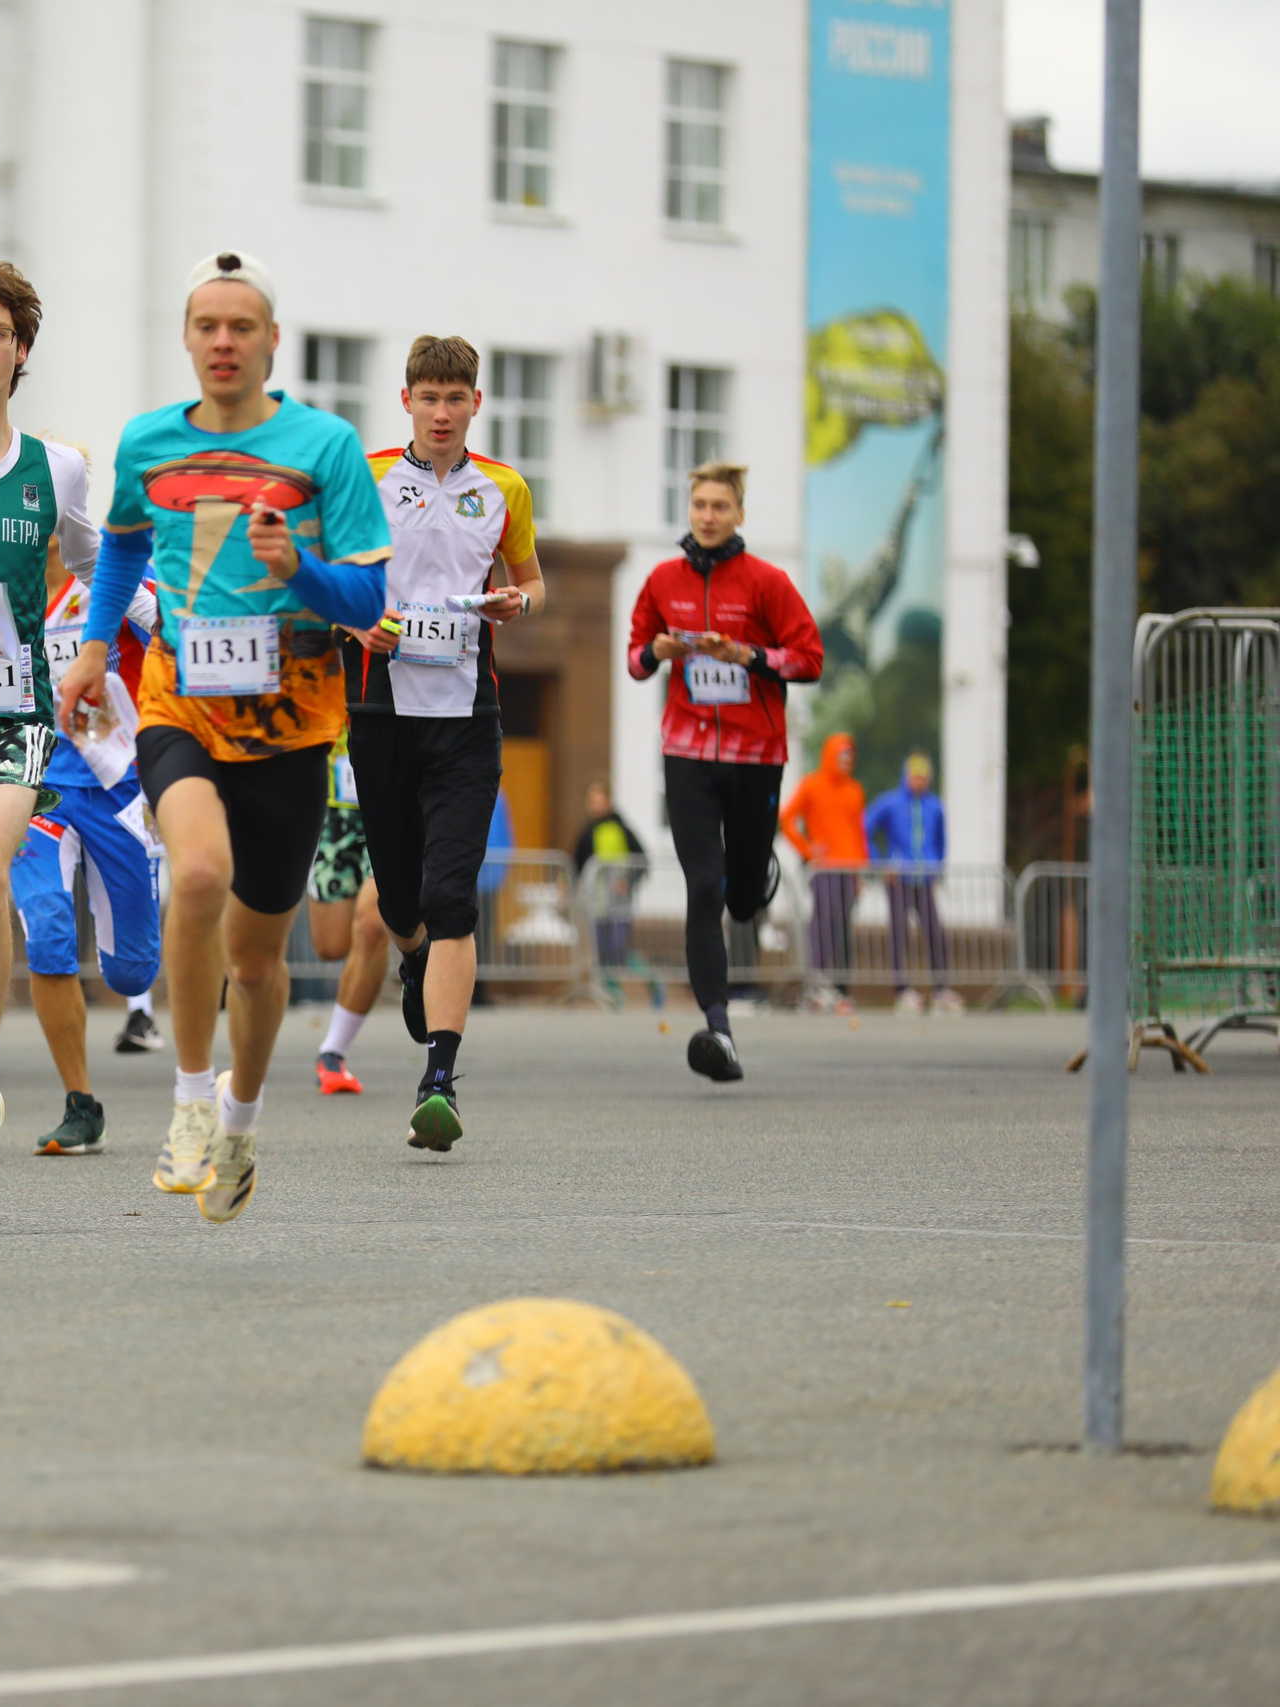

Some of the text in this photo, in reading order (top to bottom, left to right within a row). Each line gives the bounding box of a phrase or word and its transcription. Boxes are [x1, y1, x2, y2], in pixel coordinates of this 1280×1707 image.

[2, 517, 39, 547] ПЕТРА
[406, 619, 455, 640] 115.1
[43, 640, 78, 662] 2.1
[191, 638, 260, 664] 113.1
[694, 668, 736, 686] 114.1
